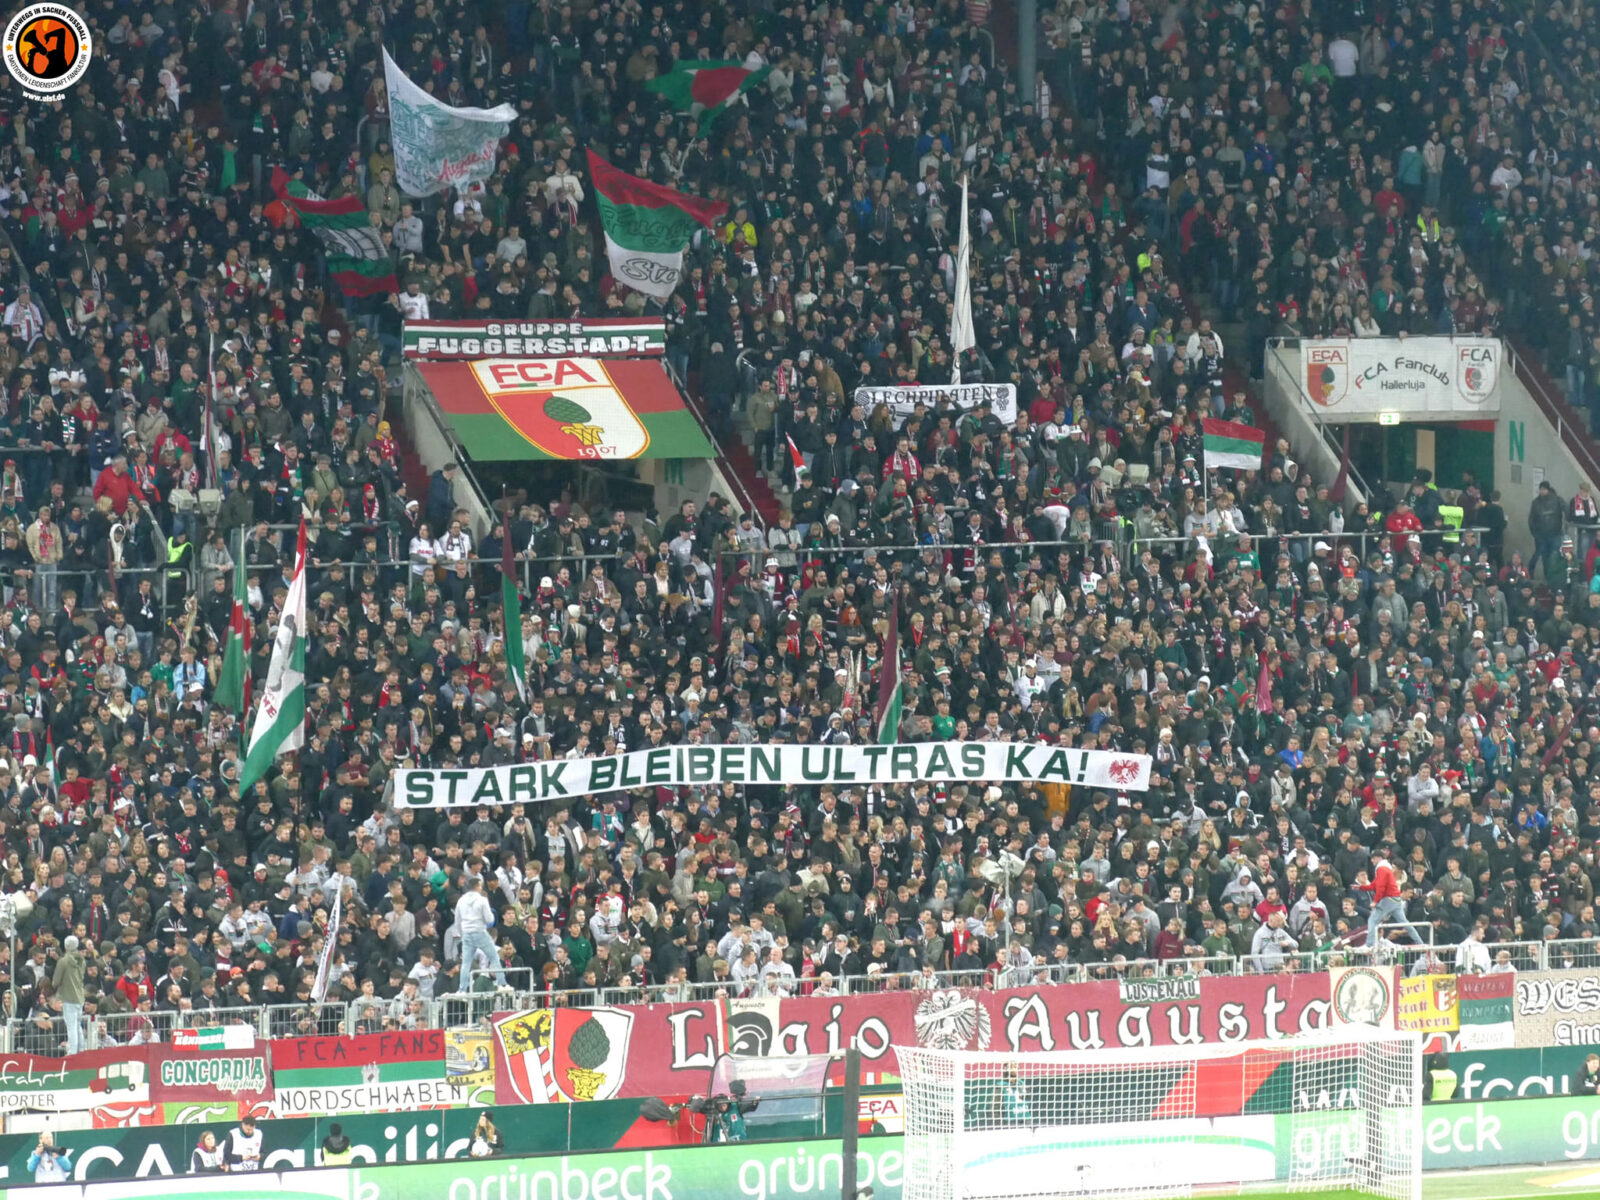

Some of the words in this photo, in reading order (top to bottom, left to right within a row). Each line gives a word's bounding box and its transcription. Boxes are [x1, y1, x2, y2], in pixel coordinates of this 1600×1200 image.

[486, 322, 584, 337] GRUPPE
[416, 335, 651, 355] FUGGERSTADT
[1312, 350, 1343, 362] FCA
[1460, 348, 1493, 362] FCA
[489, 359, 598, 387] FCA
[1355, 361, 1389, 390] FCA
[1394, 357, 1450, 387] Fanclub
[1380, 380, 1426, 391] Hallerluja
[576, 445, 617, 458] 1907
[1509, 420, 1525, 462] N
[405, 762, 569, 805] STARK
[587, 745, 782, 792] BLEIBEN
[801, 743, 986, 781] ULTRAS
[1004, 745, 1090, 782] KA!
[1124, 978, 1197, 1001] LUSTENAU
[297, 1041, 347, 1062] FCA
[380, 1033, 442, 1057] FANS
[667, 1002, 892, 1078] Lgio
[161, 1056, 265, 1086] CONCORDIA
[280, 1081, 462, 1111] NORDSCHWABEN
